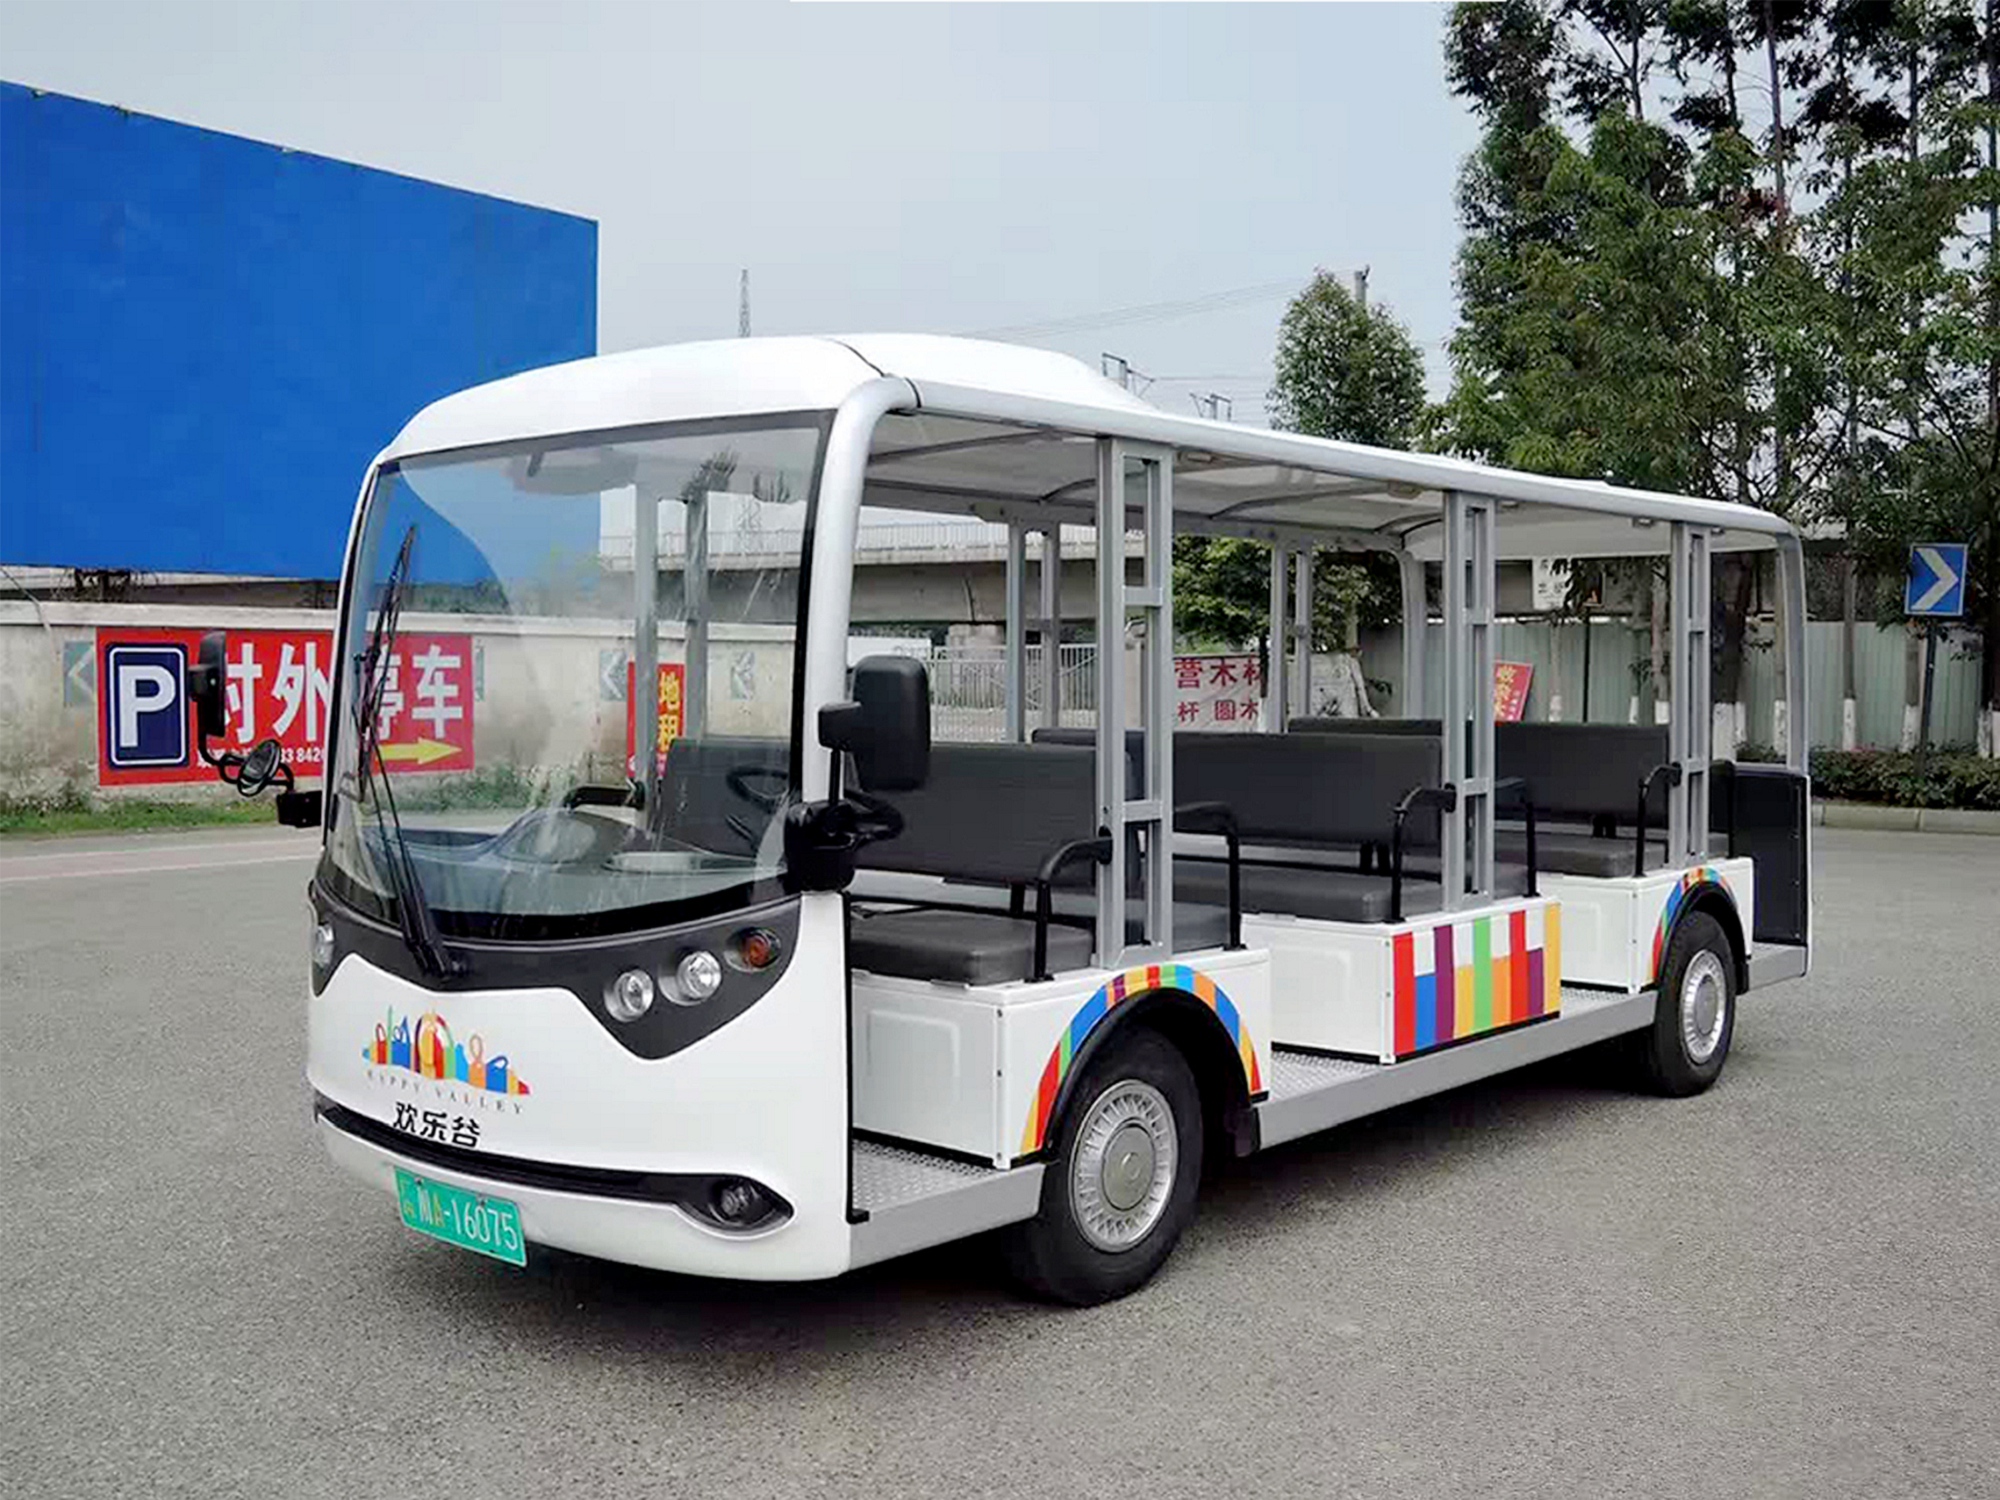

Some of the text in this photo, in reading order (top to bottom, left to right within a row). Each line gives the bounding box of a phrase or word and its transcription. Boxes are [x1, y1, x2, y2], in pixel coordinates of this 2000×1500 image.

[118, 664, 176, 747] P
[435, 1086, 523, 1115] VALLEY
[393, 1101, 481, 1148] 欢乐谷
